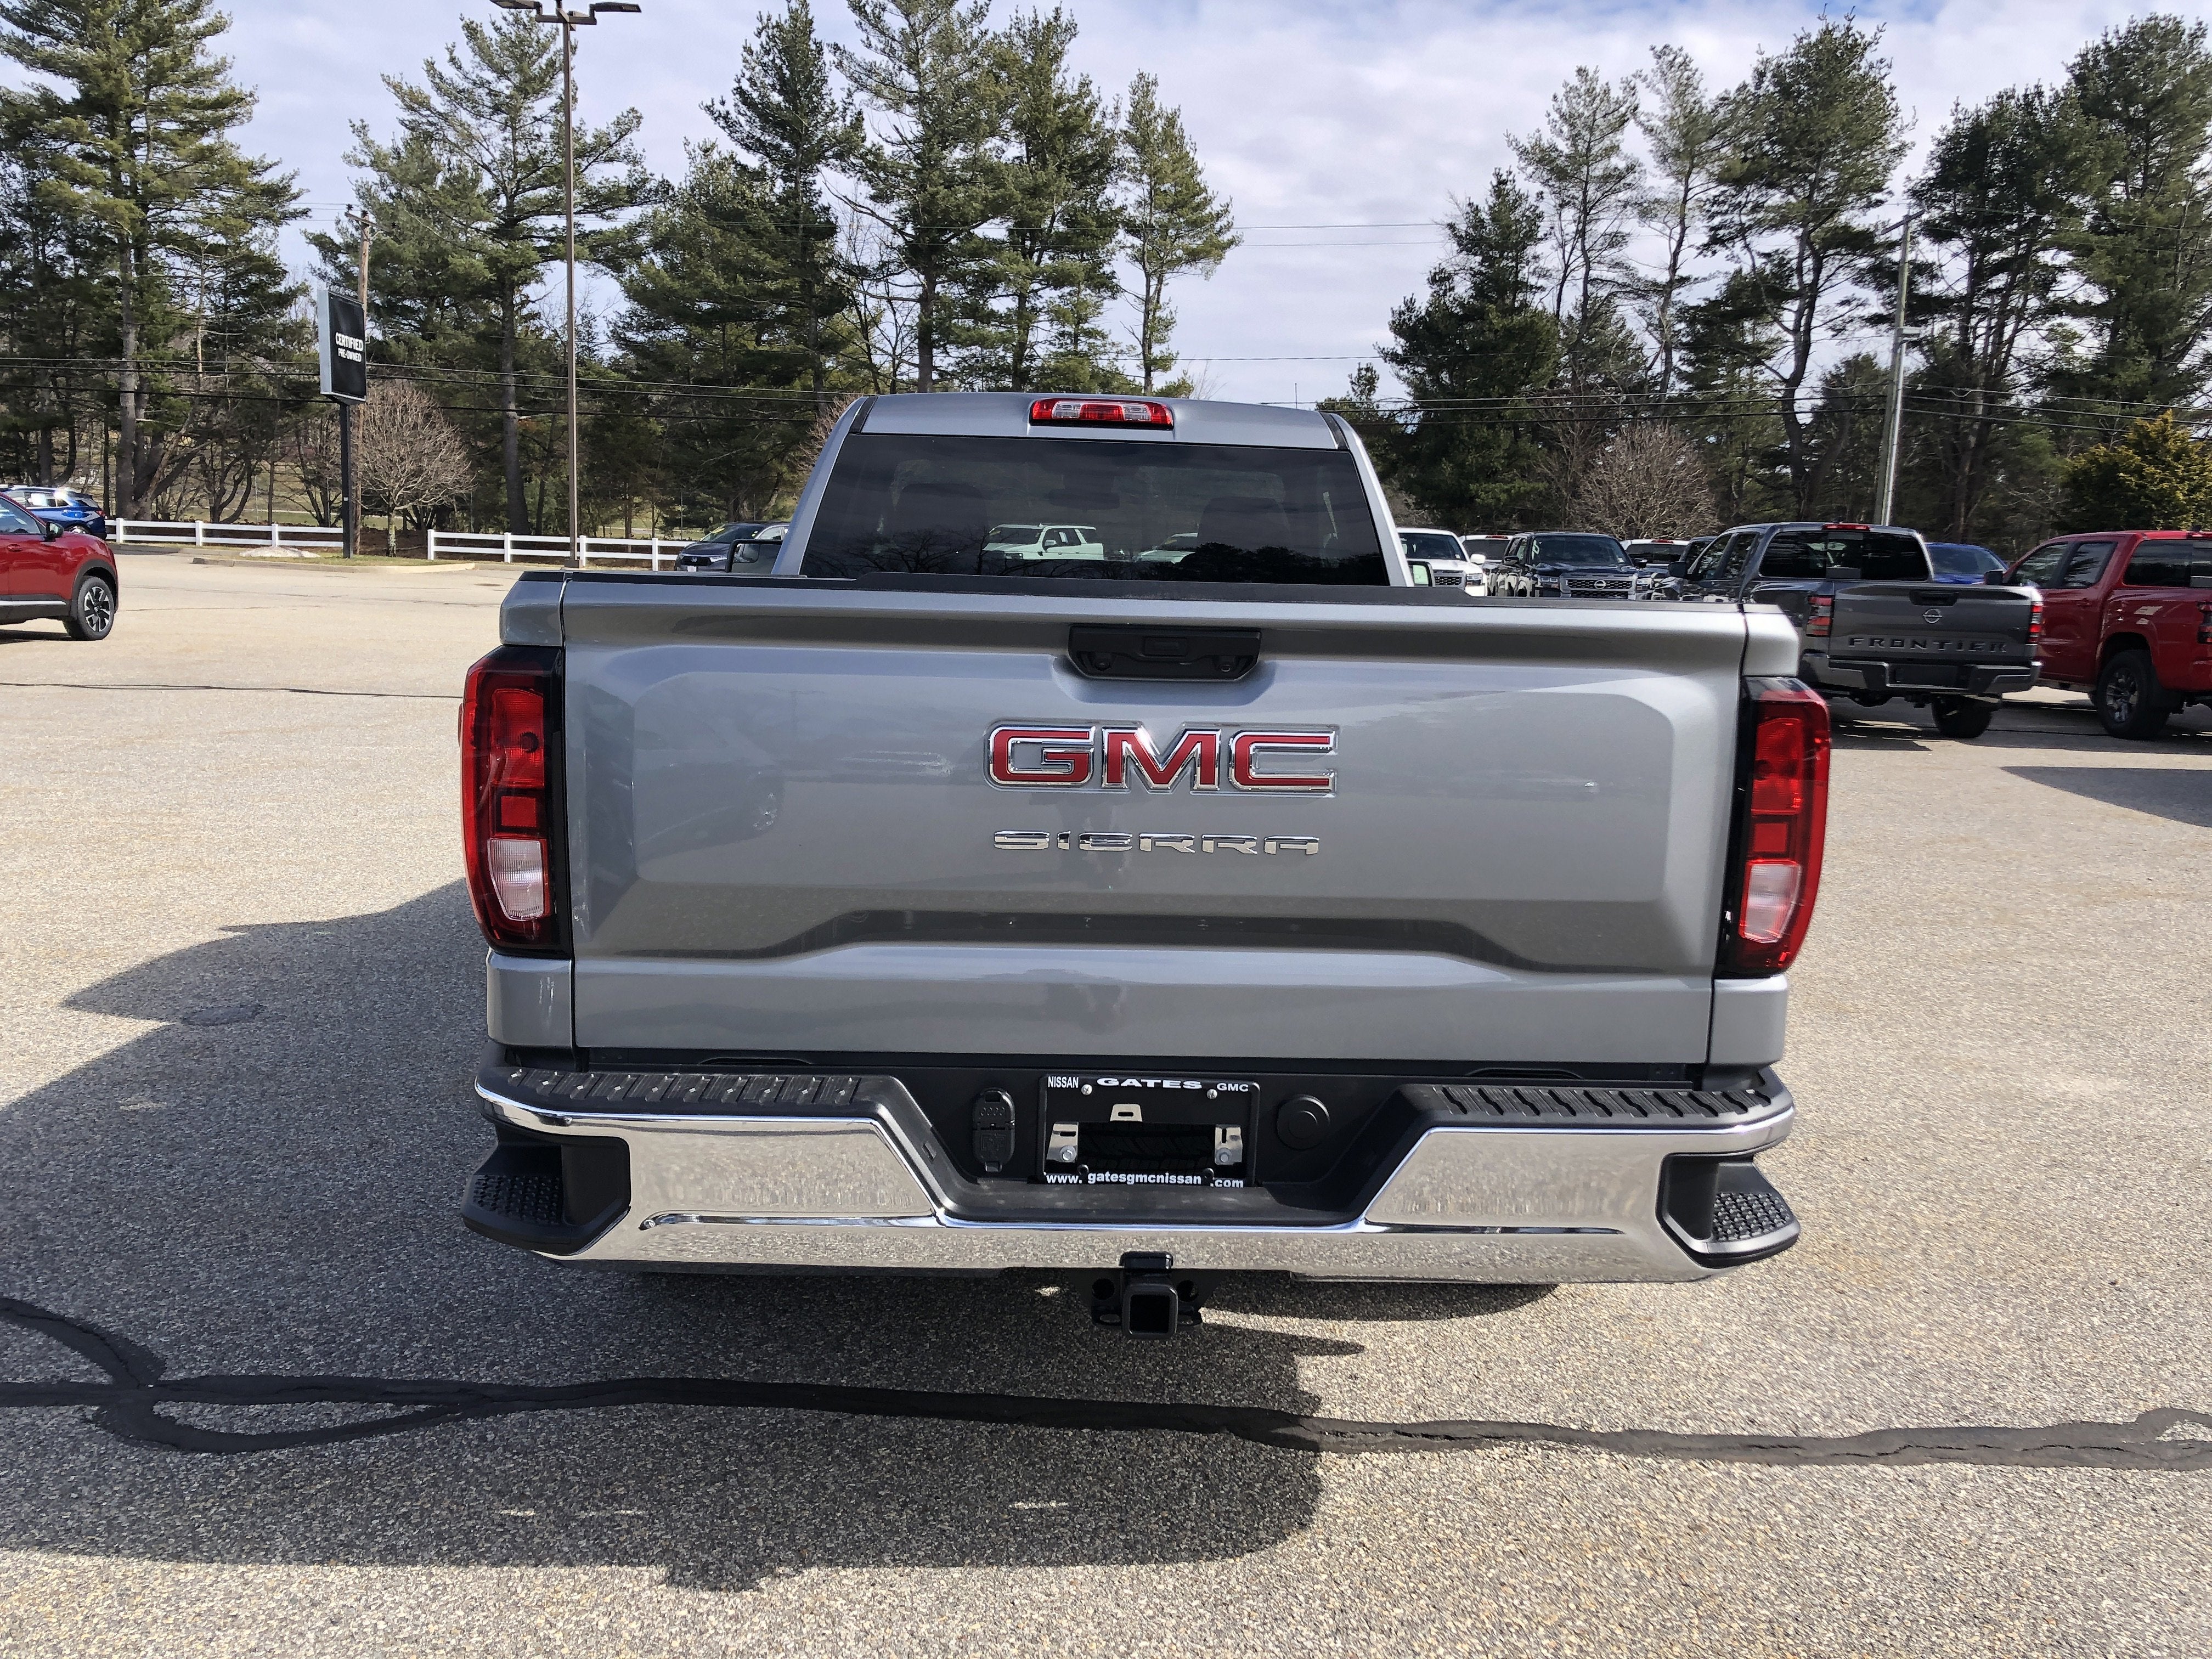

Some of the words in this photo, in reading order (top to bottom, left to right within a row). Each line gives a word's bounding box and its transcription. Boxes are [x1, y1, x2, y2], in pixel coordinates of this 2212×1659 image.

[335, 332, 364, 351] CERTIFIED
[338, 347, 362, 362] PRE-OWNED
[1848, 637, 2007, 653] FRONTIER
[986, 723, 1338, 796] GMC
[994, 830, 1320, 855] SIERRA
[1047, 1076, 1079, 1088] NISSAN
[1097, 1077, 1203, 1090] GATES
[1216, 1082, 1249, 1092] GMC
[1046, 1174, 1082, 1184] www.
[1087, 1172, 1201, 1185] gatesgmcnissan
[1210, 1179, 1244, 1188] .com
